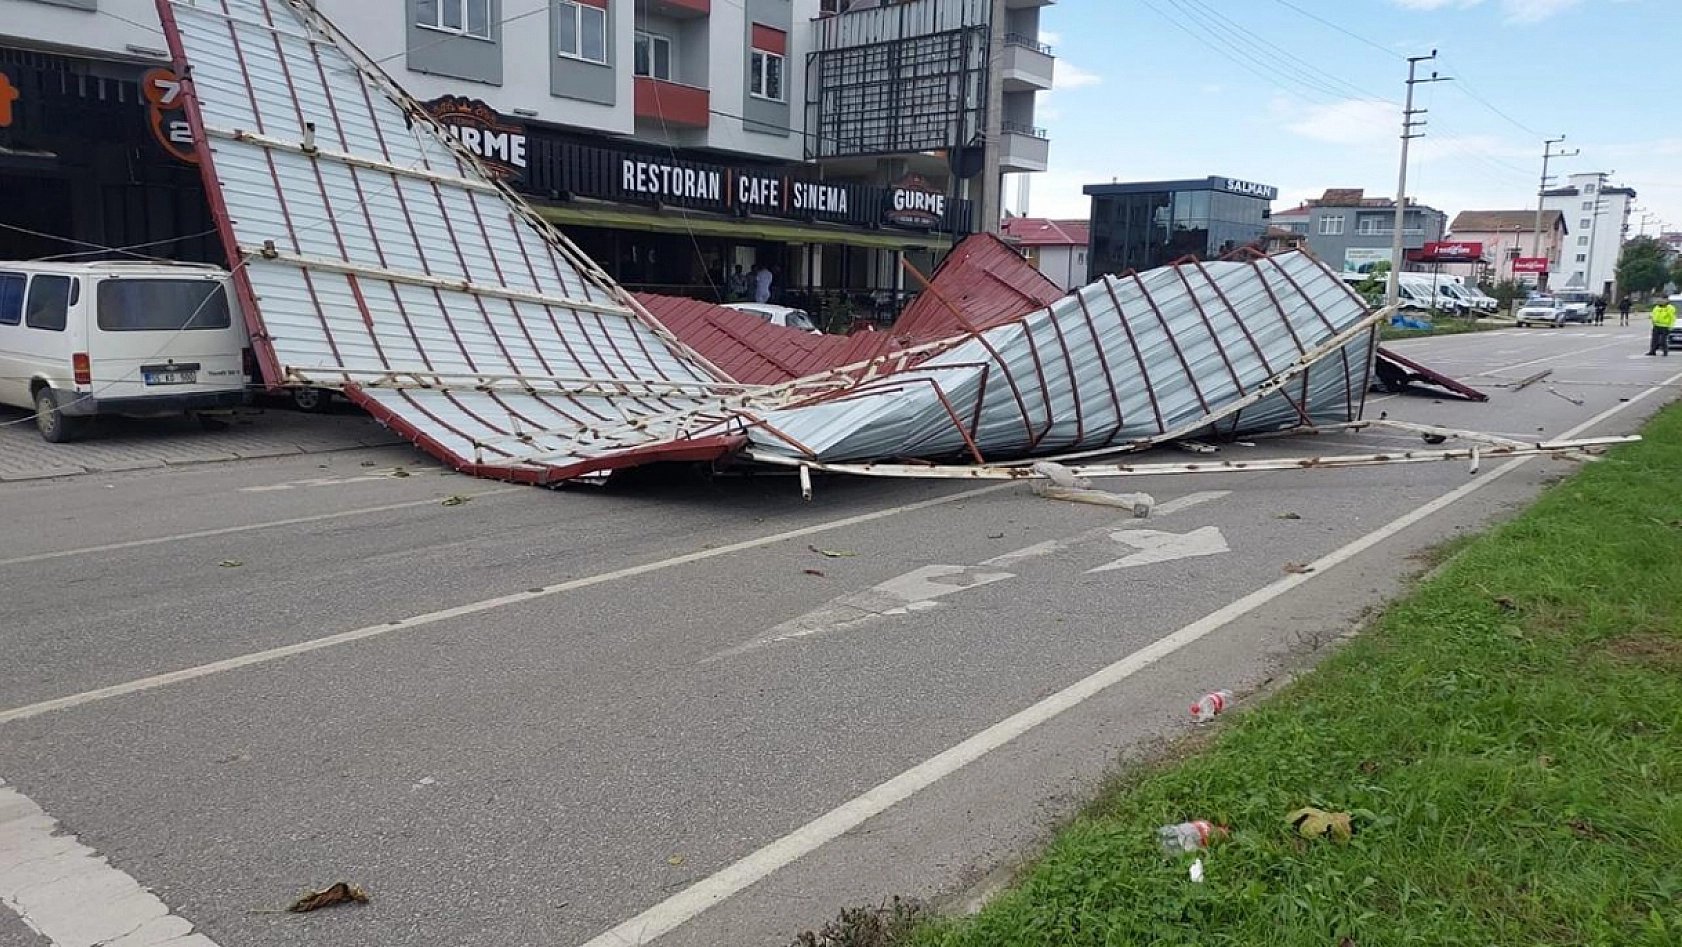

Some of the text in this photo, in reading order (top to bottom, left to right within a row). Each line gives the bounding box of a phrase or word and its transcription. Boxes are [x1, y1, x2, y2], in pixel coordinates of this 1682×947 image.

[154, 78, 181, 104] 7
[622, 159, 719, 200] RESTORAN
[738, 176, 779, 207] CAFE
[1227, 178, 1271, 197] SALMAN
[894, 188, 944, 216] GURME
